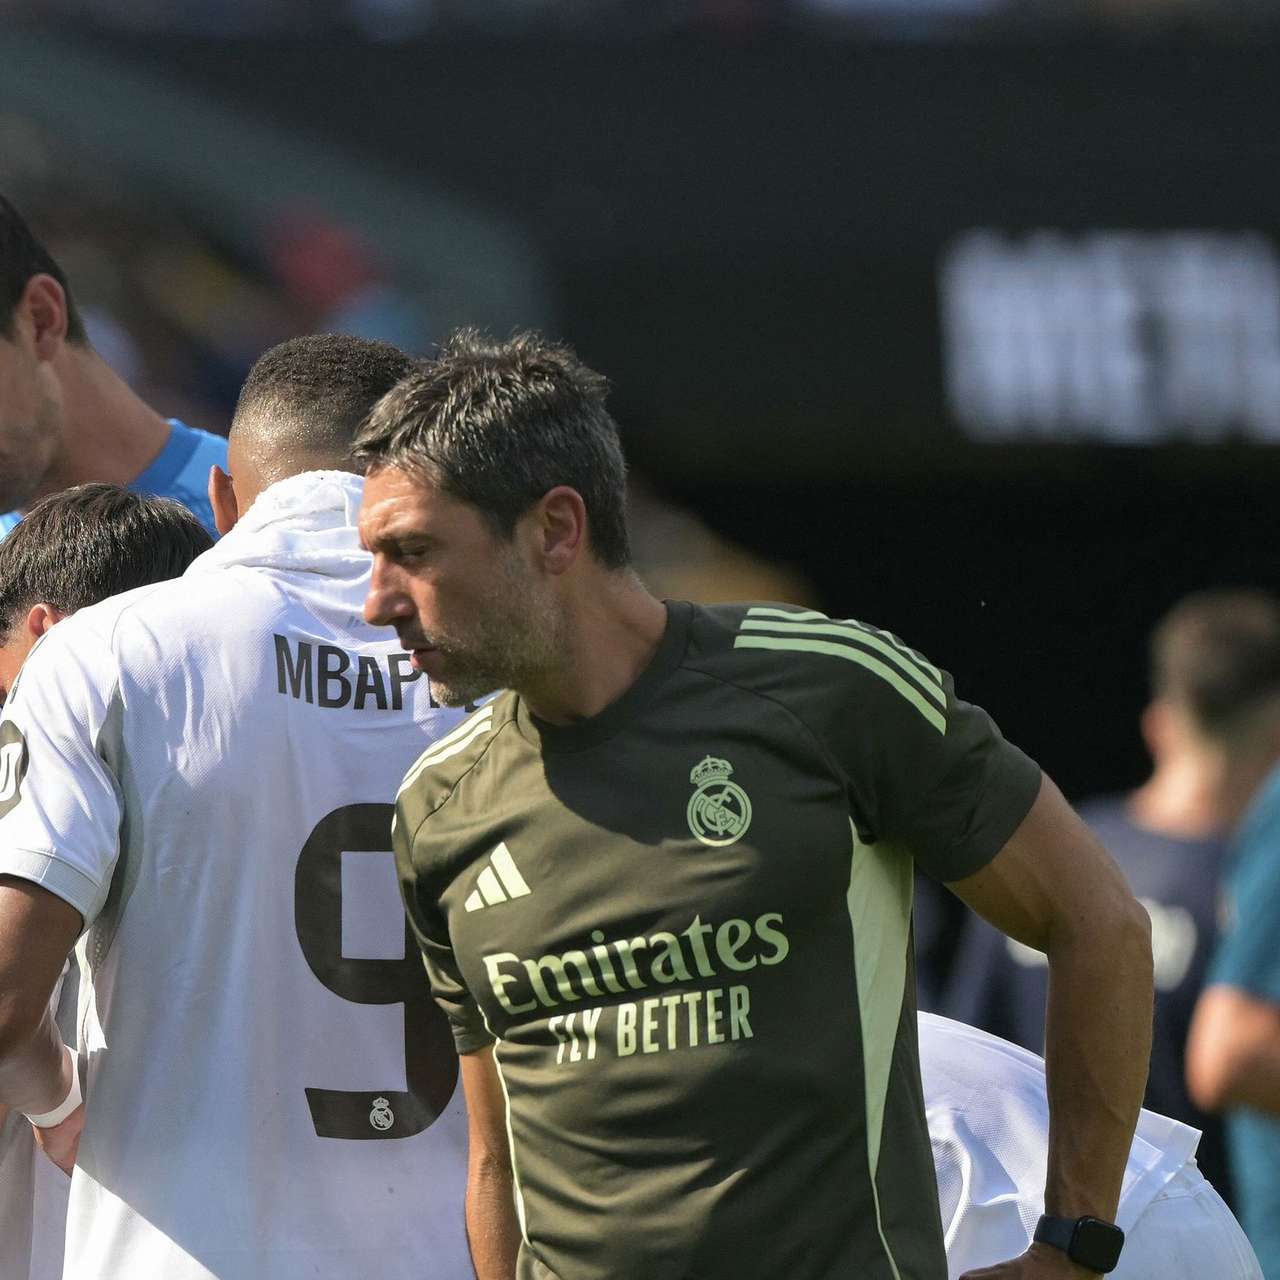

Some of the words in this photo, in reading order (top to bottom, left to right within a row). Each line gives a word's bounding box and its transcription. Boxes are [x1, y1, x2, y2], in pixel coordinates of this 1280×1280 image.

[273, 634, 440, 711] MBAP
[294, 803, 459, 1140] 9
[483, 913, 790, 1015] Emirates
[549, 1007, 602, 1065] FLY
[617, 985, 754, 1058] BETTER
